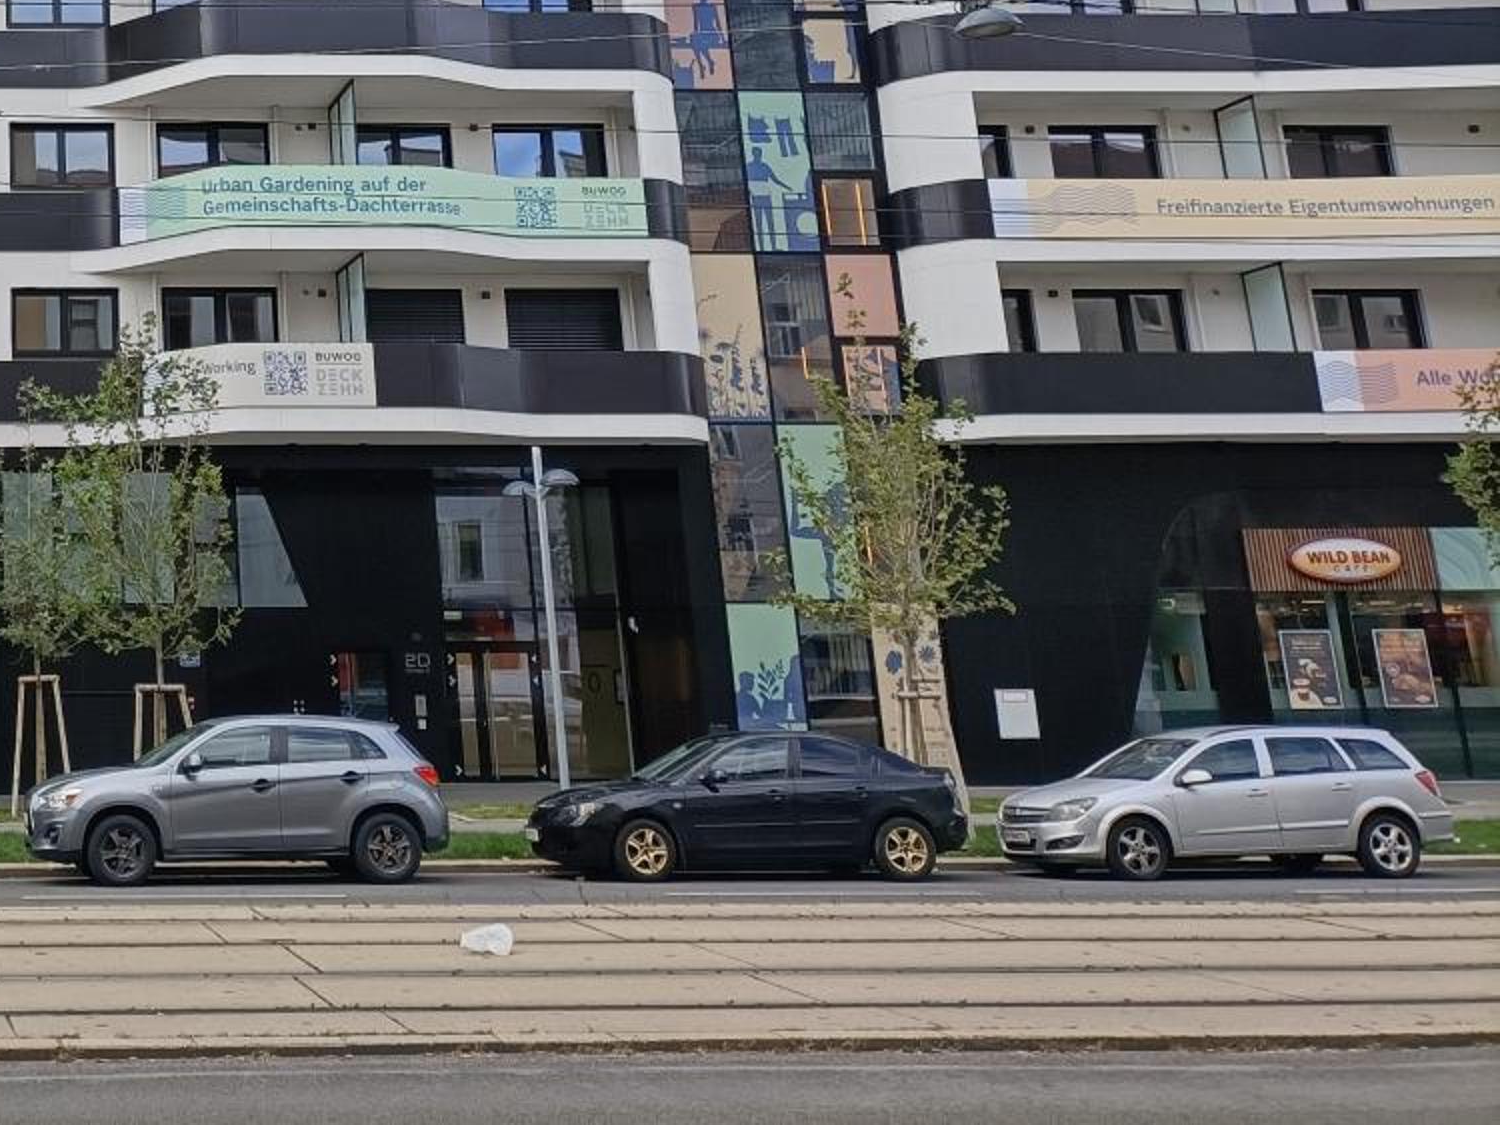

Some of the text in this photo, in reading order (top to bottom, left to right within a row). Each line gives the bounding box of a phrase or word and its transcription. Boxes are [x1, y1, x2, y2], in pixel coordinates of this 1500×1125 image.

[202, 175, 427, 196] Urban Gardening auf der
[581, 186, 627, 196] BUWOG
[203, 196, 462, 216] Gemeinschafts-Dachterrasse
[1157, 196, 1495, 217] Freifinanzierte Eigentumswohnungen
[315, 352, 362, 362] BUWOG
[316, 369, 363, 382] DECK
[1417, 369, 1452, 386] Alle
[317, 383, 364, 395] ZEHN
[1306, 551, 1391, 564] WILD BEAN
